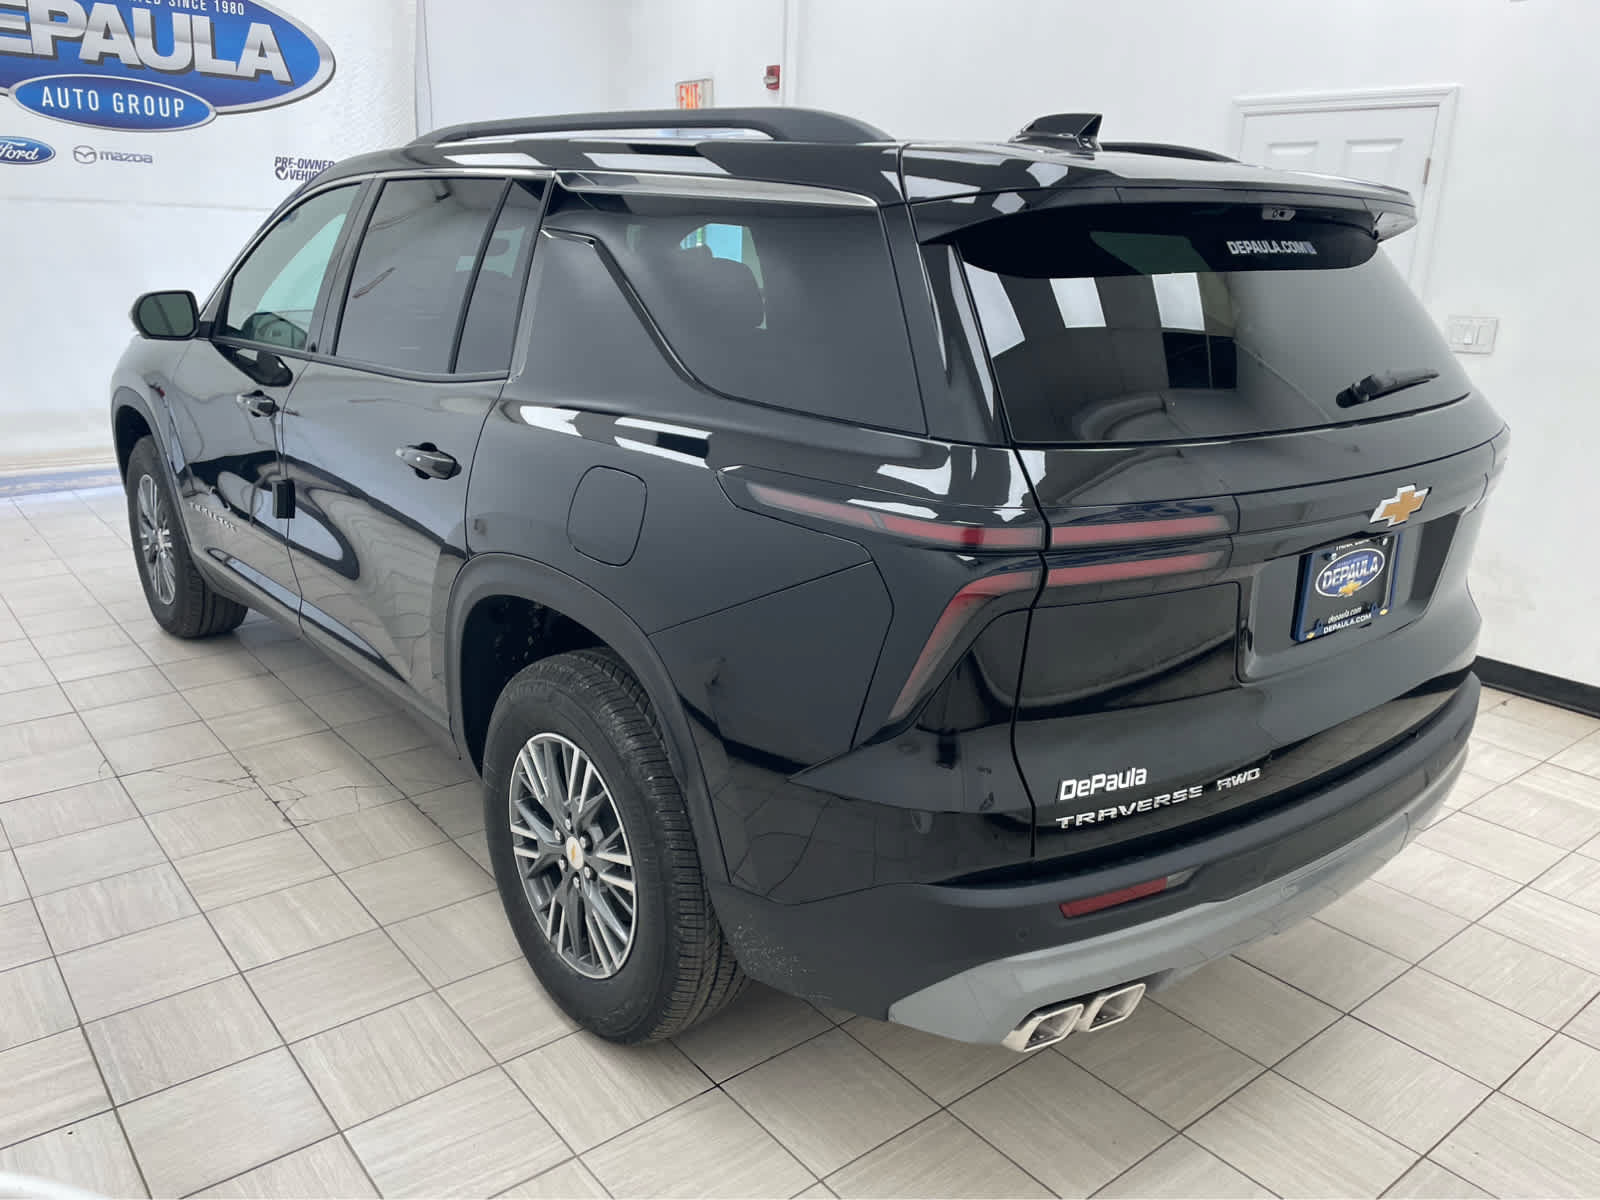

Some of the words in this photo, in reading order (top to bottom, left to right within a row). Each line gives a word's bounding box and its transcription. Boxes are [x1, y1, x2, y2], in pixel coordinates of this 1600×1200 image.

[215, 0, 245, 16] 1980
[41, 86, 100, 112] AUTO
[113, 93, 186, 119] GROUP
[679, 84, 700, 110] EXIT
[1226, 240, 1310, 254] DEPAULA.COM
[1322, 556, 1378, 589] DEPAULA
[1323, 613, 1372, 634] DEPAULA.COM
[1055, 785, 1205, 830] TRAVERSE
[1216, 767, 1262, 792] AWD
[1059, 767, 1148, 801] DePaula
